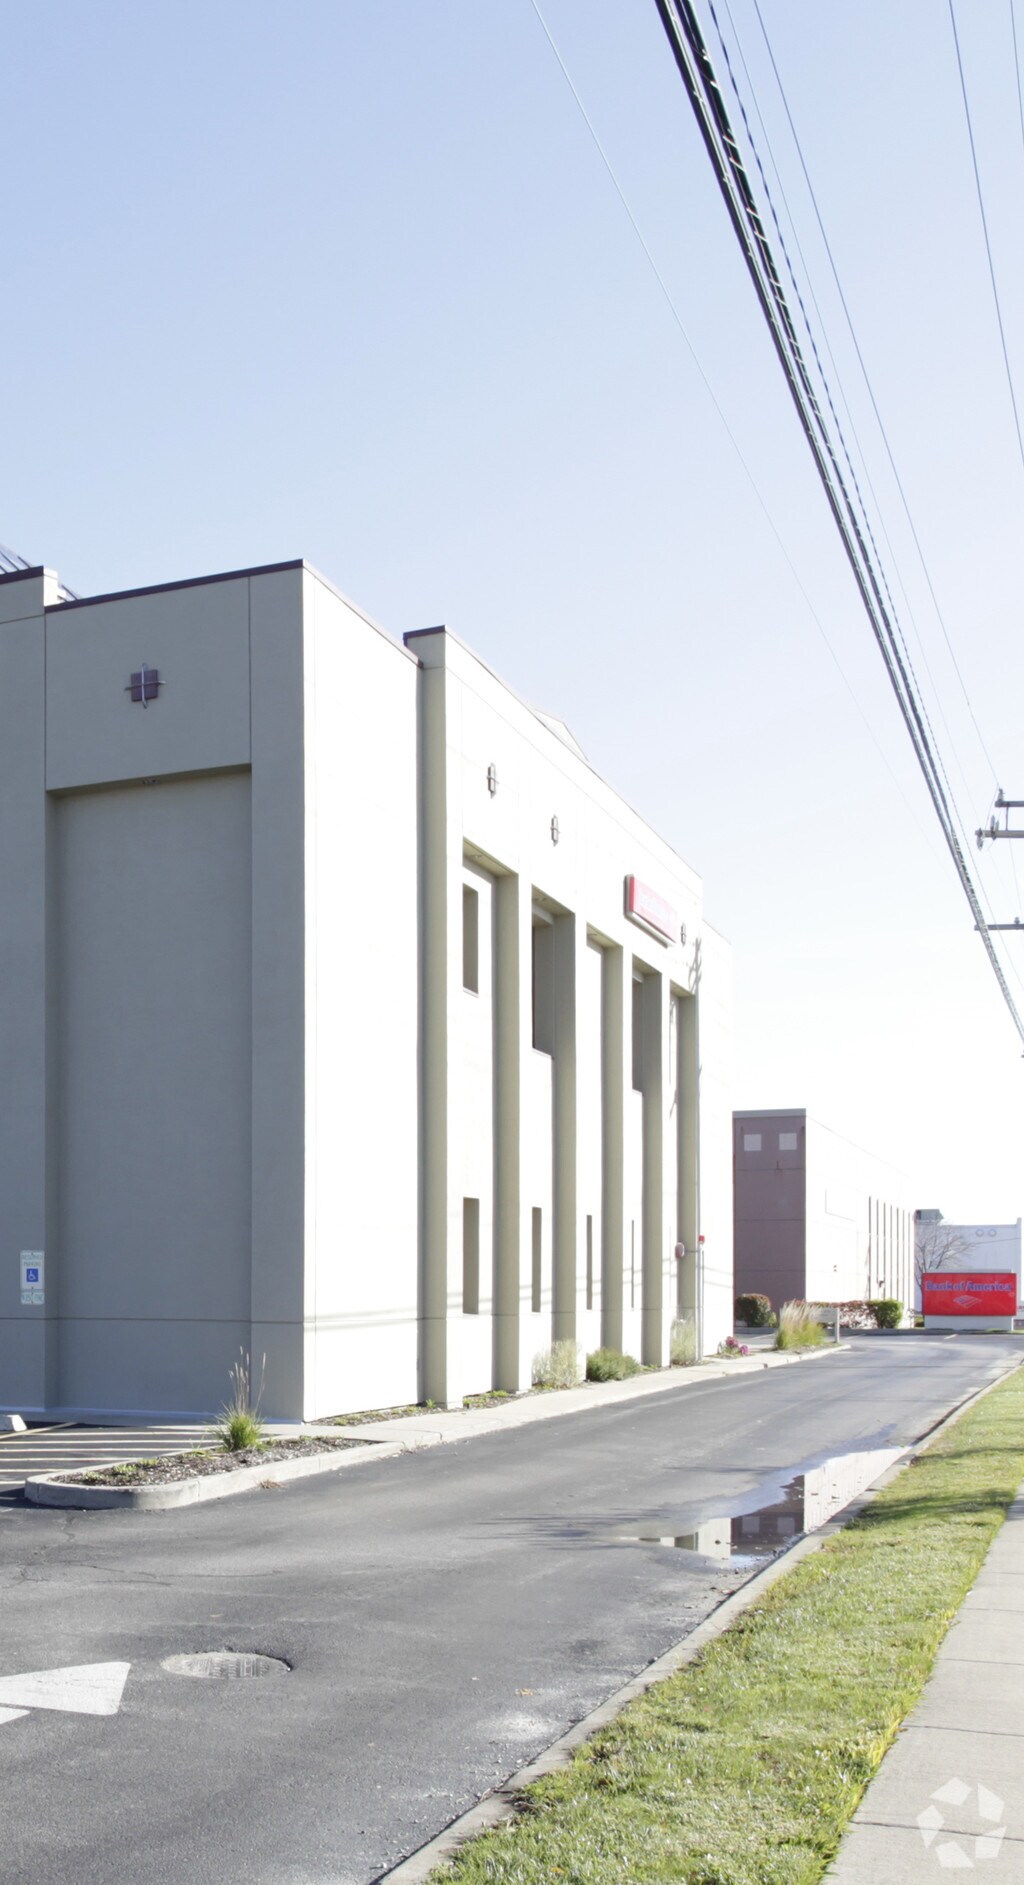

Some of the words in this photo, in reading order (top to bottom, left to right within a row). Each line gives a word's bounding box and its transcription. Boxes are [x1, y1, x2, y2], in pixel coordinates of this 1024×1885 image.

[926, 1280, 953, 1291] Bank
[953, 1280, 965, 1291] of
[964, 1280, 1013, 1292] America
